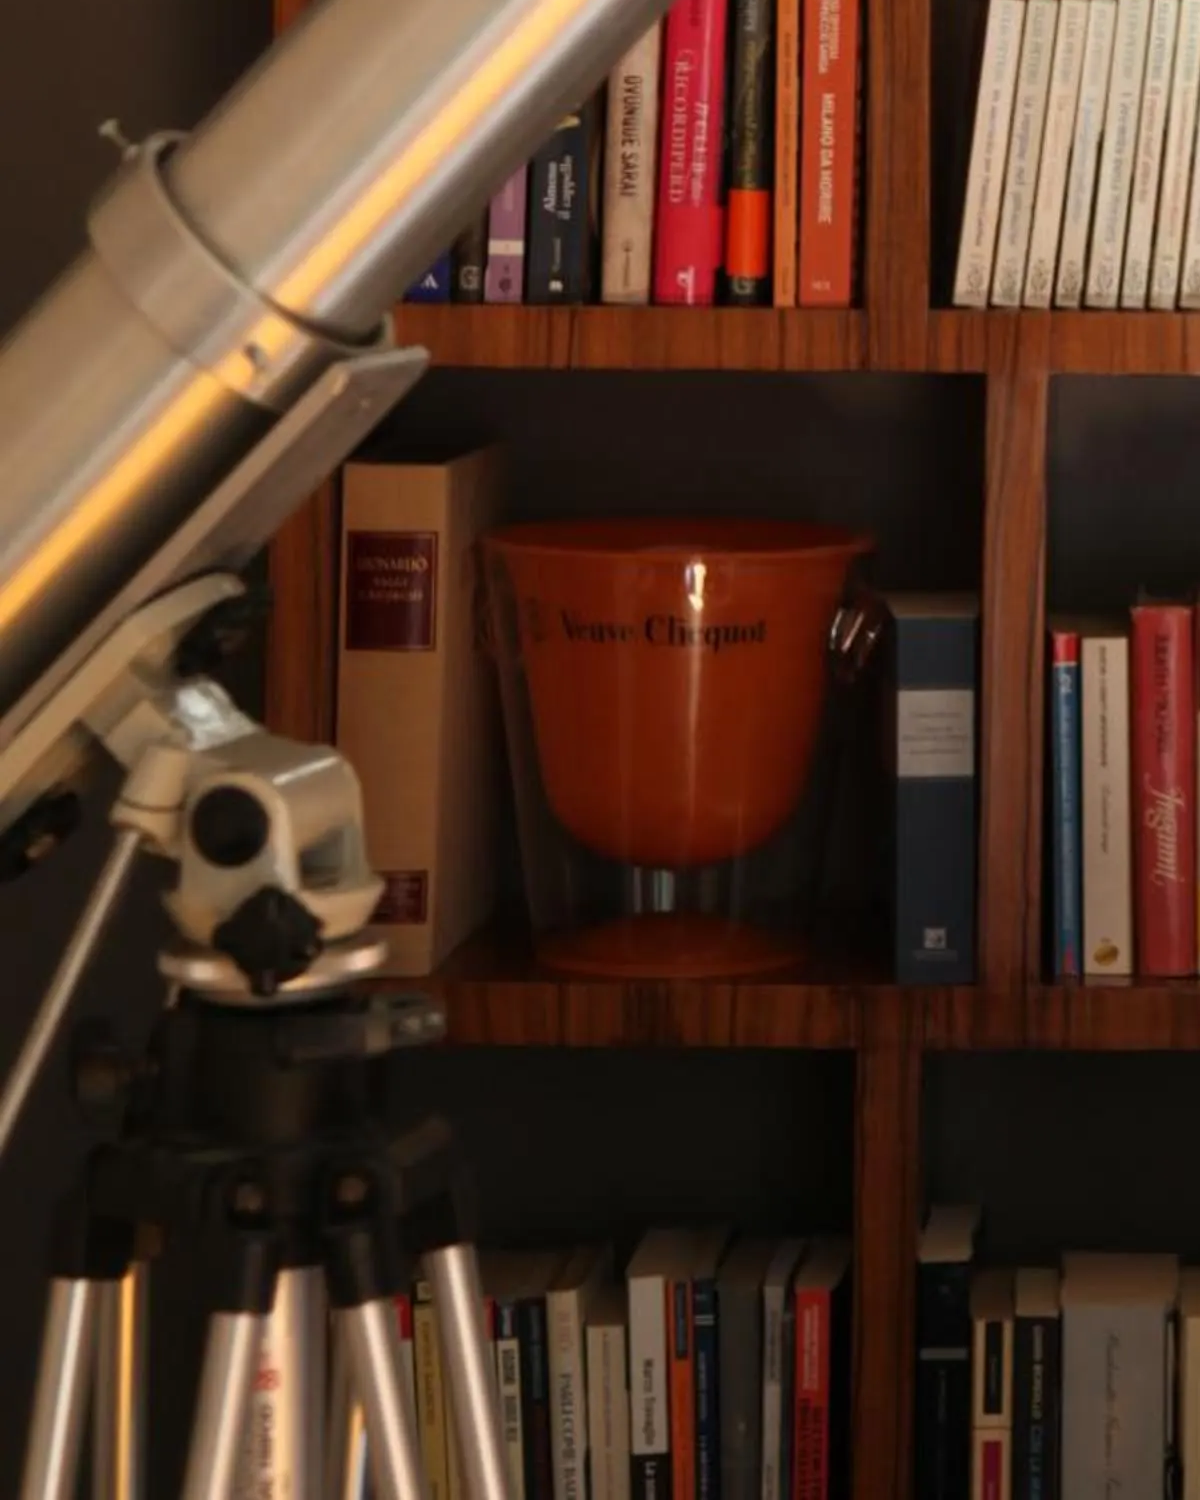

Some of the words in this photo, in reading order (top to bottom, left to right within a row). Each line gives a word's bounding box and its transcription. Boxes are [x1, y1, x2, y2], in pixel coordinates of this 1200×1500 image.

[621, 75, 643, 147] OVUNQUE
[820, 92, 836, 146] MILANO
[619, 151, 641, 198] SARAI
[820, 148, 834, 167] DA
[817, 170, 833, 225] MORIRE
[559, 606, 636, 645] Veuve
[644, 613, 768, 657] Clicquot
[643, 1357, 656, 1394] Marco
[642, 1396, 657, 1447] Travaglio
